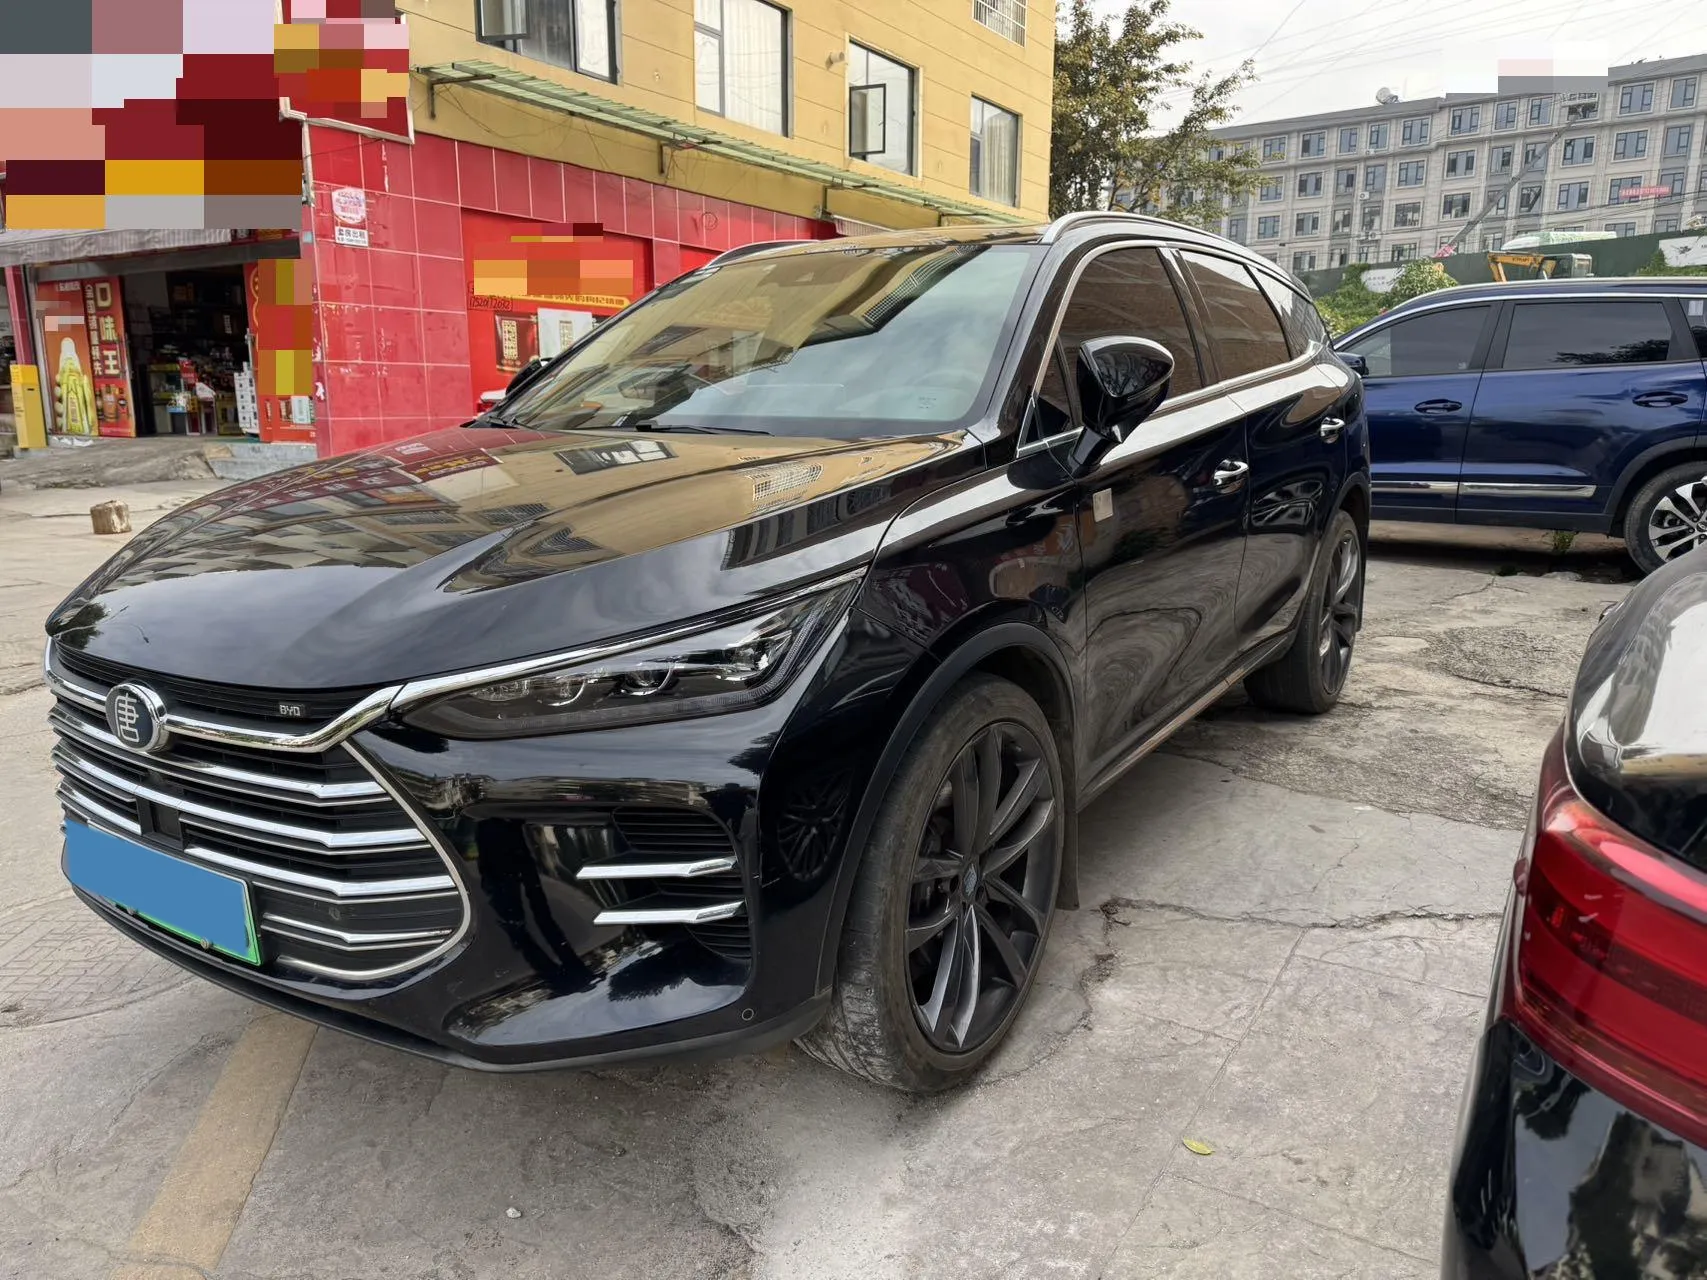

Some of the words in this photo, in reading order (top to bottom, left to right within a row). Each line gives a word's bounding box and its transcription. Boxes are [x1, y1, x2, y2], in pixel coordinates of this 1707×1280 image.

[95, 282, 120, 375] 口味王
[279, 704, 301, 717] BYD
